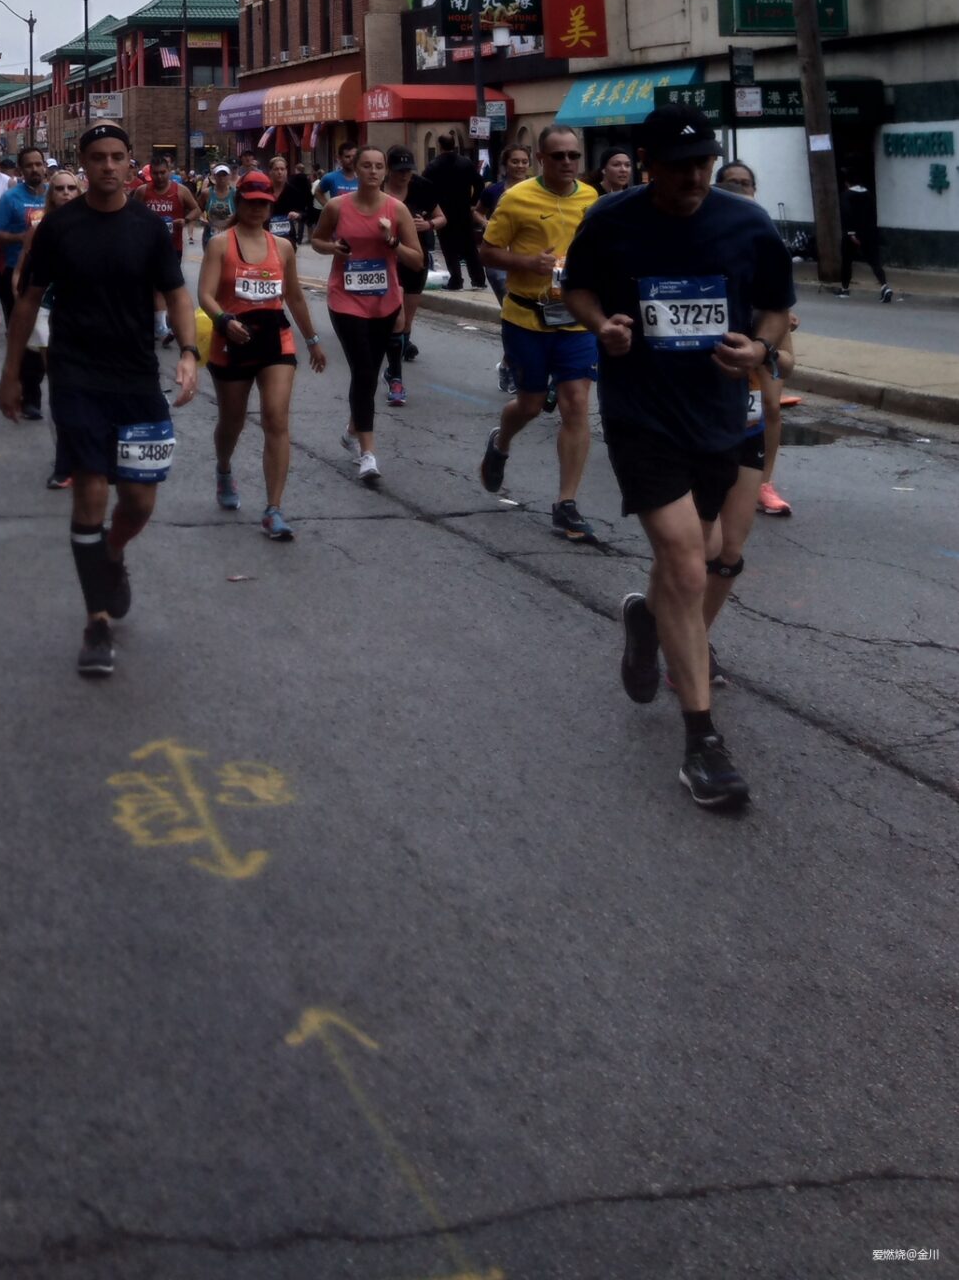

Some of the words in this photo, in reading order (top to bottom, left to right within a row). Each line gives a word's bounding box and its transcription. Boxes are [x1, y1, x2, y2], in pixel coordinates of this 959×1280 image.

[345, 274, 352, 285] G
[357, 272, 386, 285] 39236
[242, 280, 250, 292] D
[253, 281, 277, 295] 1833
[645, 305, 658, 326] G
[669, 304, 725, 325] 37275
[121, 443, 129, 459] G
[138, 443, 175, 461] 34887
